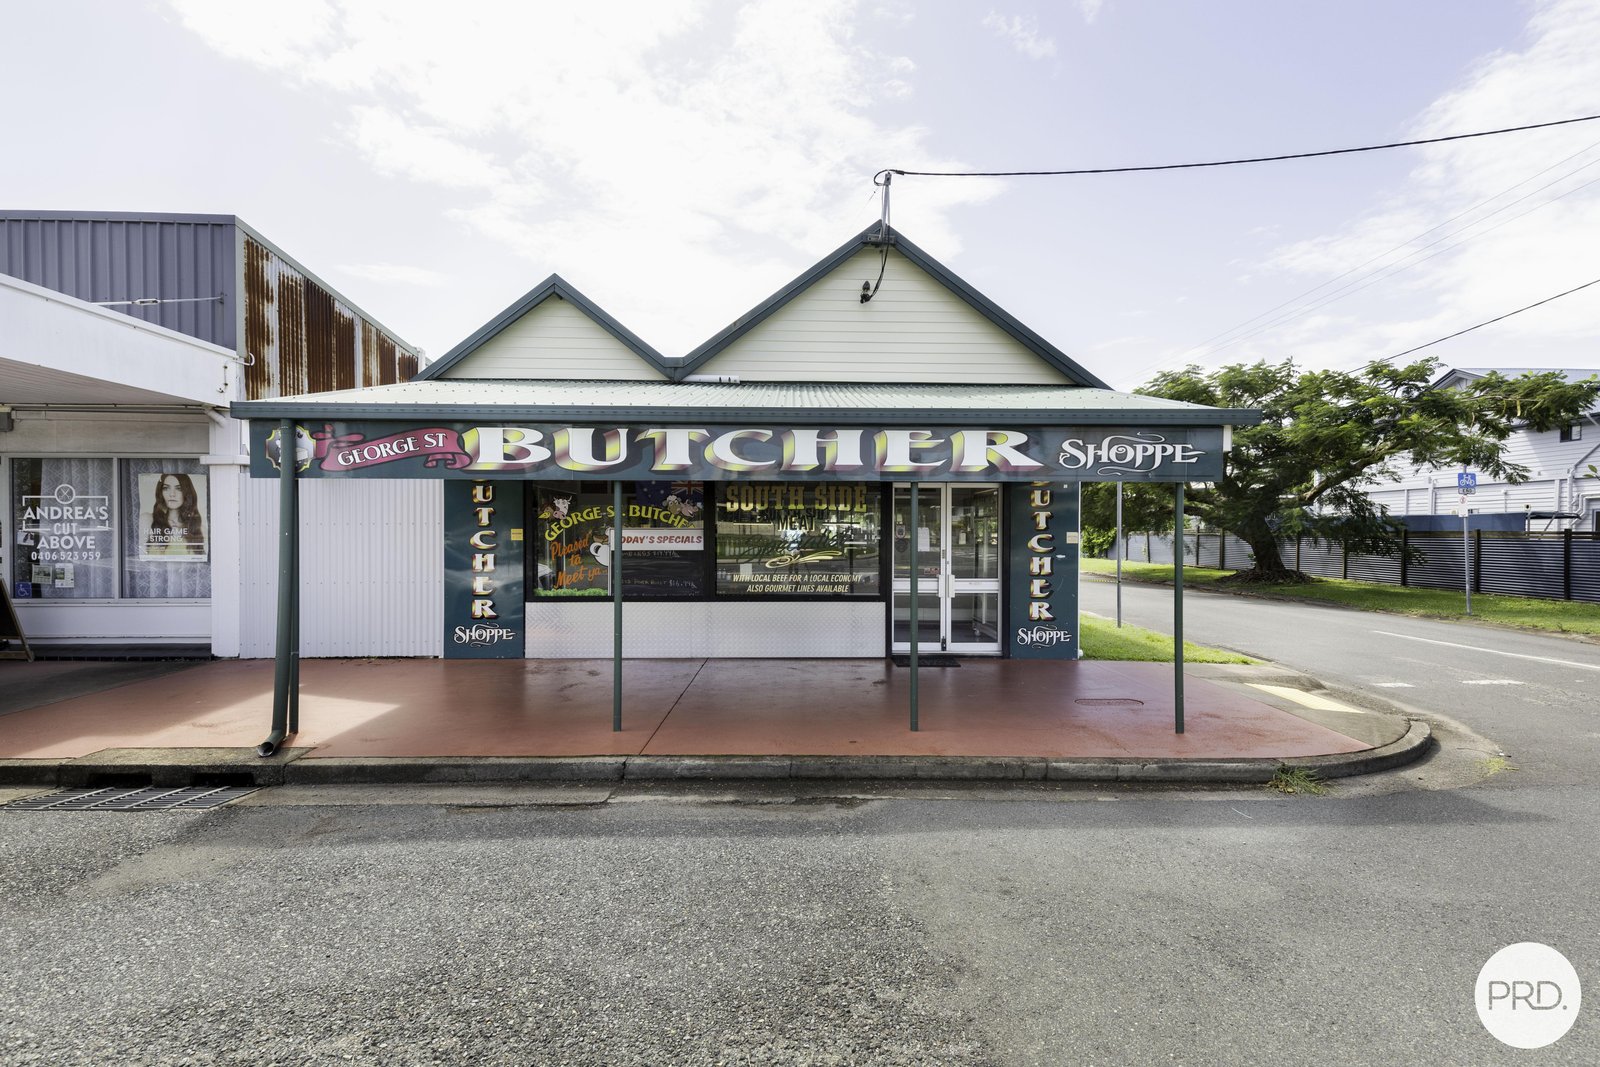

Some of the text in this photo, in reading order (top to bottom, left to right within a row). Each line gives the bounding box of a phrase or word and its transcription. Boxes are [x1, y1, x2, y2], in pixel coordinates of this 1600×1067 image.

[337, 437, 420, 466] GEORGE
[463, 427, 1044, 471] BUTCHER
[1059, 433, 1206, 475] SHOPPE
[726, 484, 867, 513] SOUTH SIDE
[23, 506, 109, 520] ANDREA'S
[544, 506, 602, 541] GEORGE
[777, 514, 815, 531] MEAT
[53, 522, 78, 535] CUT
[143, 527, 188, 535] HAIR GAME
[149, 535, 183, 543] STRONG
[621, 535, 702, 545] ODAY'S SPECIALS
[36, 535, 96, 549] ABOVE
[469, 480, 499, 619] UTCHER
[551, 529, 592, 561] Pleased
[1027, 481, 1055, 620] UTCHER
[31, 551, 101, 561] 0406 523 959
[553, 565, 588, 589] Meet
[733, 574, 751, 583] WITH
[751, 574, 771, 583] LOCAL
[772, 574, 789, 583] BEEF
[789, 574, 802, 583] FOR
[803, 574, 808, 583] A
[809, 574, 829, 583] LOCAL
[747, 584, 849, 593] ALSO GOURMET LINES AVAILABLE
[454, 622, 516, 647] SHOPPE
[1017, 624, 1072, 648] SHOPPE
